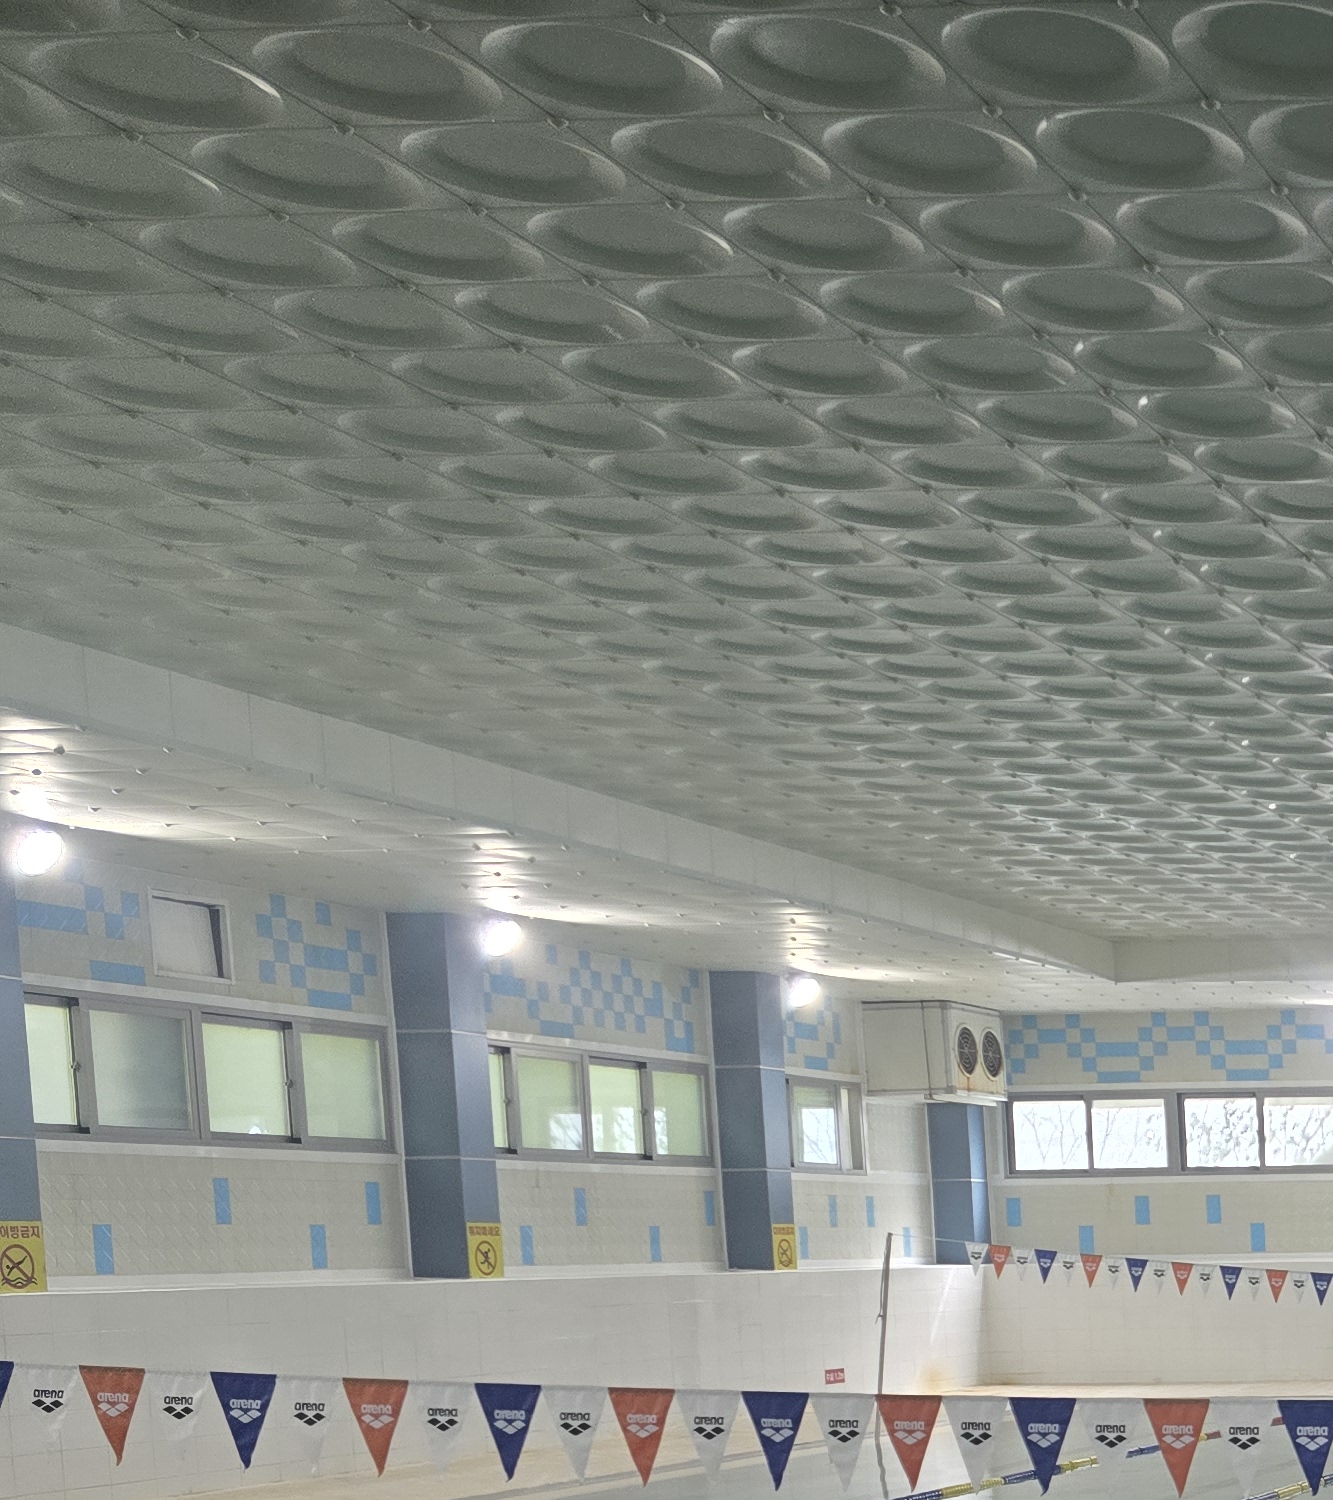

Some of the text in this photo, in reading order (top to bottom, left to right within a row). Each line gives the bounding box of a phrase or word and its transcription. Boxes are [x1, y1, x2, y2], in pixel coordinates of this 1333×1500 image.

[0, 1225, 40, 1239] 이빙금지
[33, 1389, 64, 1399] arena
[97, 1391, 128, 1403] arena
[164, 1396, 193, 1406] arena
[229, 1398, 261, 1410] arena
[294, 1402, 324, 1411] arena
[361, 1403, 391, 1415] arena
[427, 1408, 458, 1418] arena
[494, 1409, 525, 1420] arena
[560, 1412, 590, 1421] arena
[626, 1414, 657, 1424] arena
[694, 1416, 724, 1426] arena
[761, 1418, 792, 1429] arena
[828, 1419, 859, 1429] arena
[893, 1420, 924, 1431] arena
[961, 1422, 991, 1432] arena
[1027, 1423, 1059, 1434] arena
[1096, 1424, 1125, 1434] arena
[1161, 1424, 1193, 1435] arena
[1229, 1426, 1259, 1435] arena
[1296, 1425, 1328, 1436] arena
